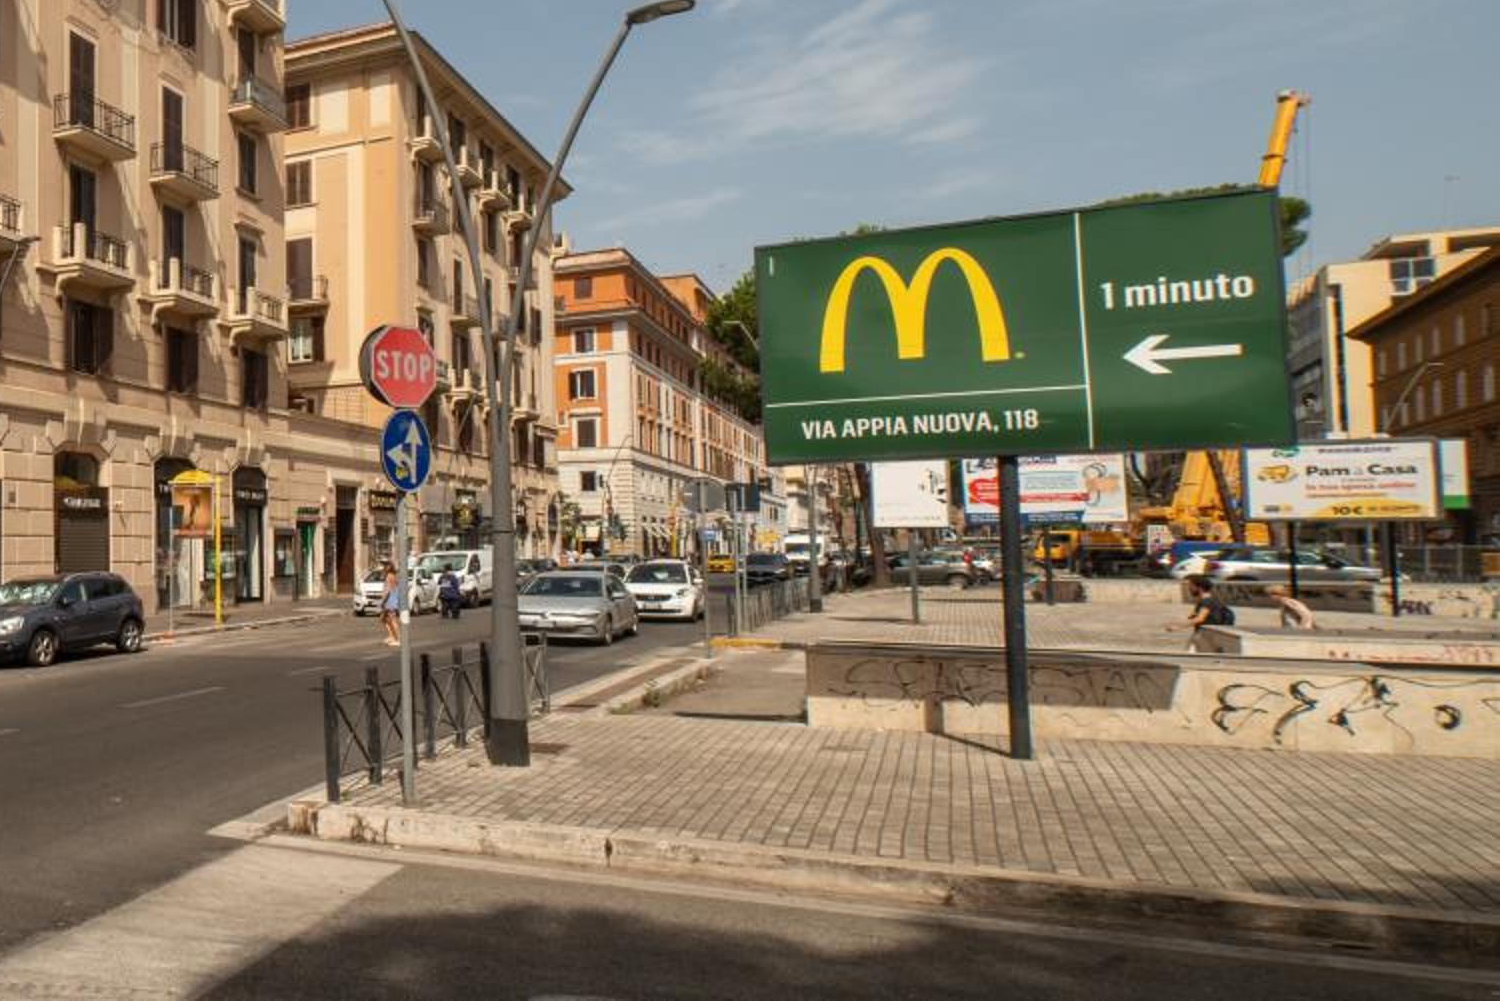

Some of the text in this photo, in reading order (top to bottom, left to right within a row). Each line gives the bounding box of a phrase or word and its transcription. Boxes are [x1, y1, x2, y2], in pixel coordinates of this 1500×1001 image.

[1100, 273, 1255, 310] 1 minuto
[376, 349, 432, 384] STOP
[801, 408, 1040, 440] VIA APPIA NUOVA, 118
[1305, 464, 1350, 477] Pam
[1367, 463, 1418, 476] Casa
